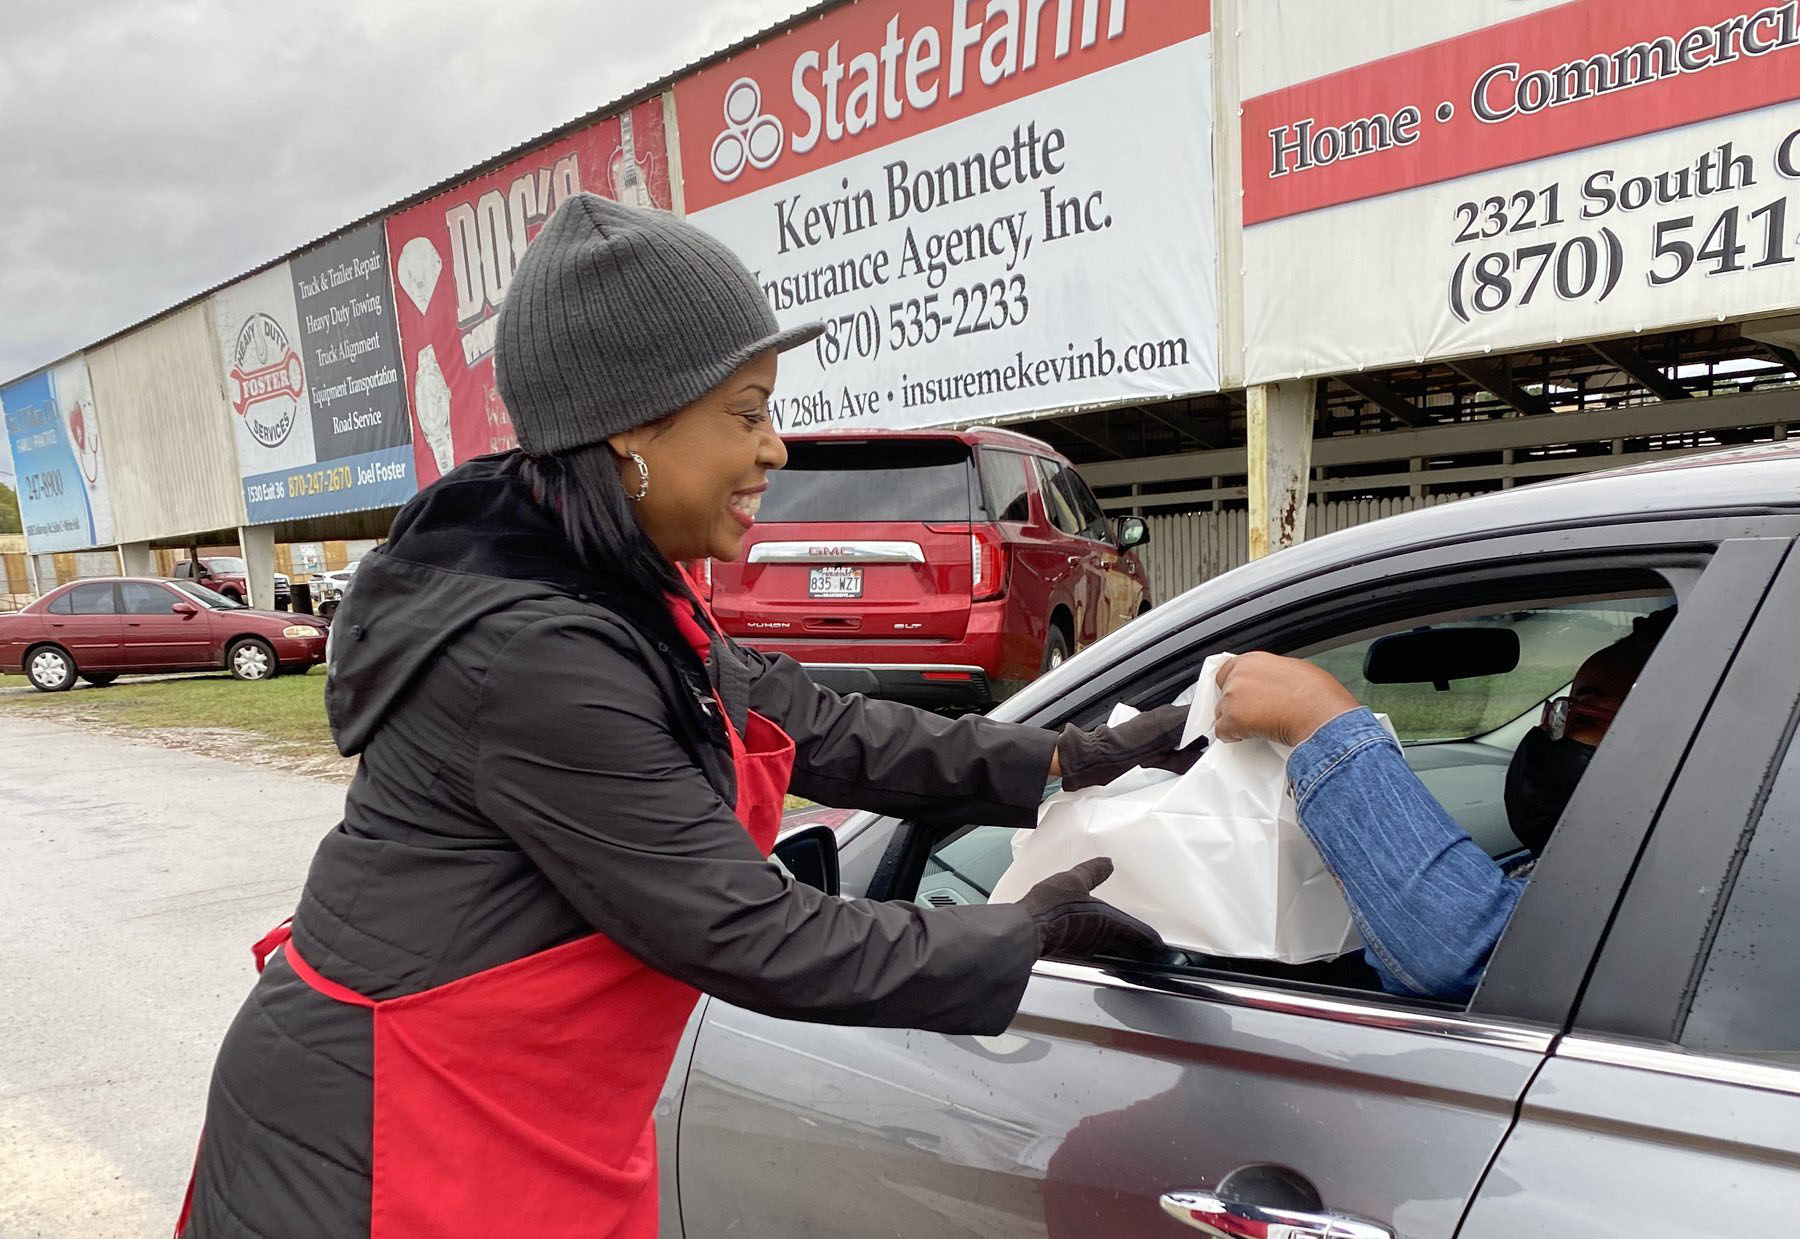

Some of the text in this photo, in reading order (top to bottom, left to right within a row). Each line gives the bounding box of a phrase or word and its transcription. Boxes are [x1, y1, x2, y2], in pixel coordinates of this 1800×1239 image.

[1269, 0, 1800, 178] Home Commerci
[774, 120, 1065, 254] Kevin Bonnette
[1455, 182, 1564, 244] 2321
[1582, 142, 1757, 220] South
[753, 185, 1112, 311] nsurance Agency, Inc.
[298, 250, 381, 300] Truck & Trailer Repair
[1450, 227, 1624, 323] (870)
[306, 293, 382, 335] Heavy Duty Towing
[889, 274, 1029, 352] 535-2233
[237, 320, 286, 367] HEAVY DUTY
[315, 331, 380, 367] Truck Alignment
[242, 369, 290, 399] FOSTER
[312, 365, 398, 409] Equipment Transportation
[790, 389, 834, 428] 28th
[838, 386, 880, 420] Ave
[902, 336, 1190, 409] insuremekevinb.com
[253, 411, 290, 441] SERVICES
[332, 407, 382, 434] Road Service
[263, 483, 276, 501] Exit
[276, 482, 285, 498] 36
[287, 465, 353, 498] 870-247-2670
[357, 462, 375, 487] Joel
[376, 461, 406, 483] Foster
[808, 546, 855, 556] GMC
[811, 577, 860, 591] 835 WZT
